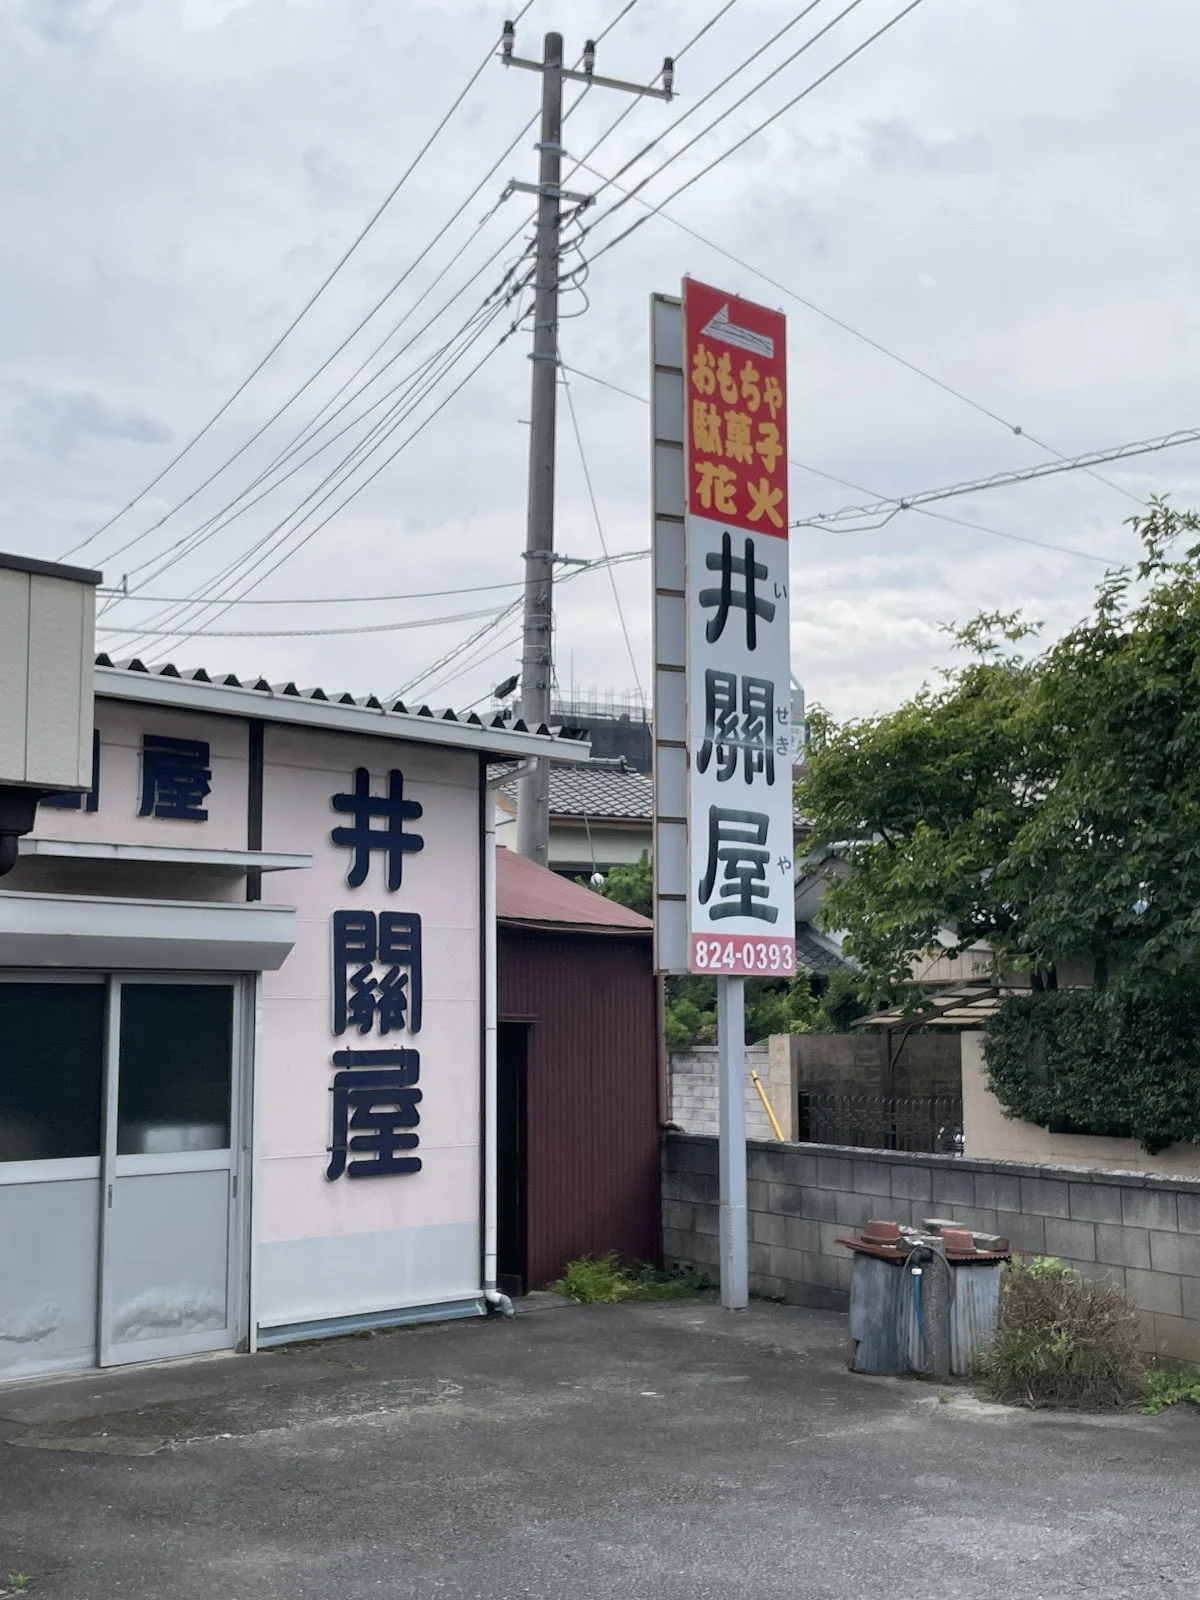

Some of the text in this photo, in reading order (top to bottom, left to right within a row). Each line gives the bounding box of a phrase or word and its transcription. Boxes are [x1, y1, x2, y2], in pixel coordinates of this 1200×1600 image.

[692, 343, 783, 420] おもちゃ
[692, 398, 784, 474] 駄菓子
[694, 461, 784, 529] 花火
[695, 939, 793, 970] 824-0393
